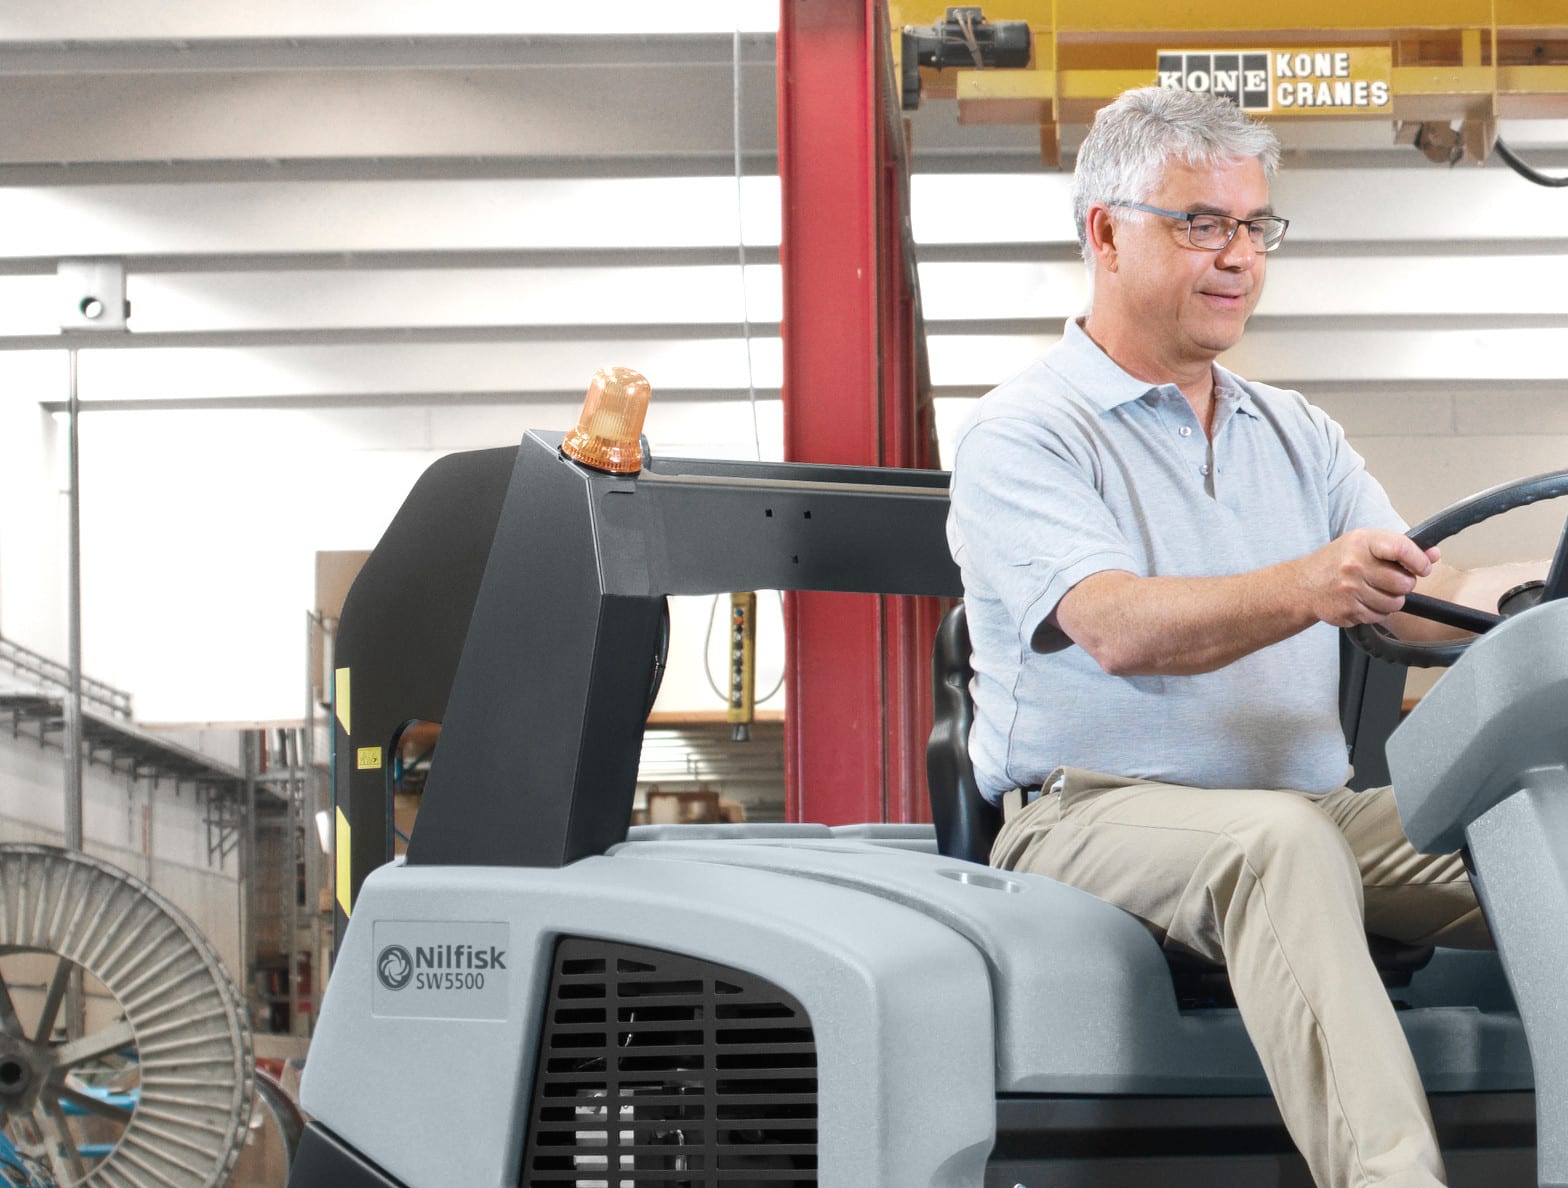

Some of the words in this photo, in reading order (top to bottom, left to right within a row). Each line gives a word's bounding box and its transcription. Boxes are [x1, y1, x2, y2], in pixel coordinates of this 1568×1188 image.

[1276, 52, 1350, 77] KONE
[1159, 70, 1266, 93] KONE
[1277, 81, 1389, 106] CRANES
[415, 944, 507, 970] Nilfisk
[416, 972, 485, 990] SW5500
